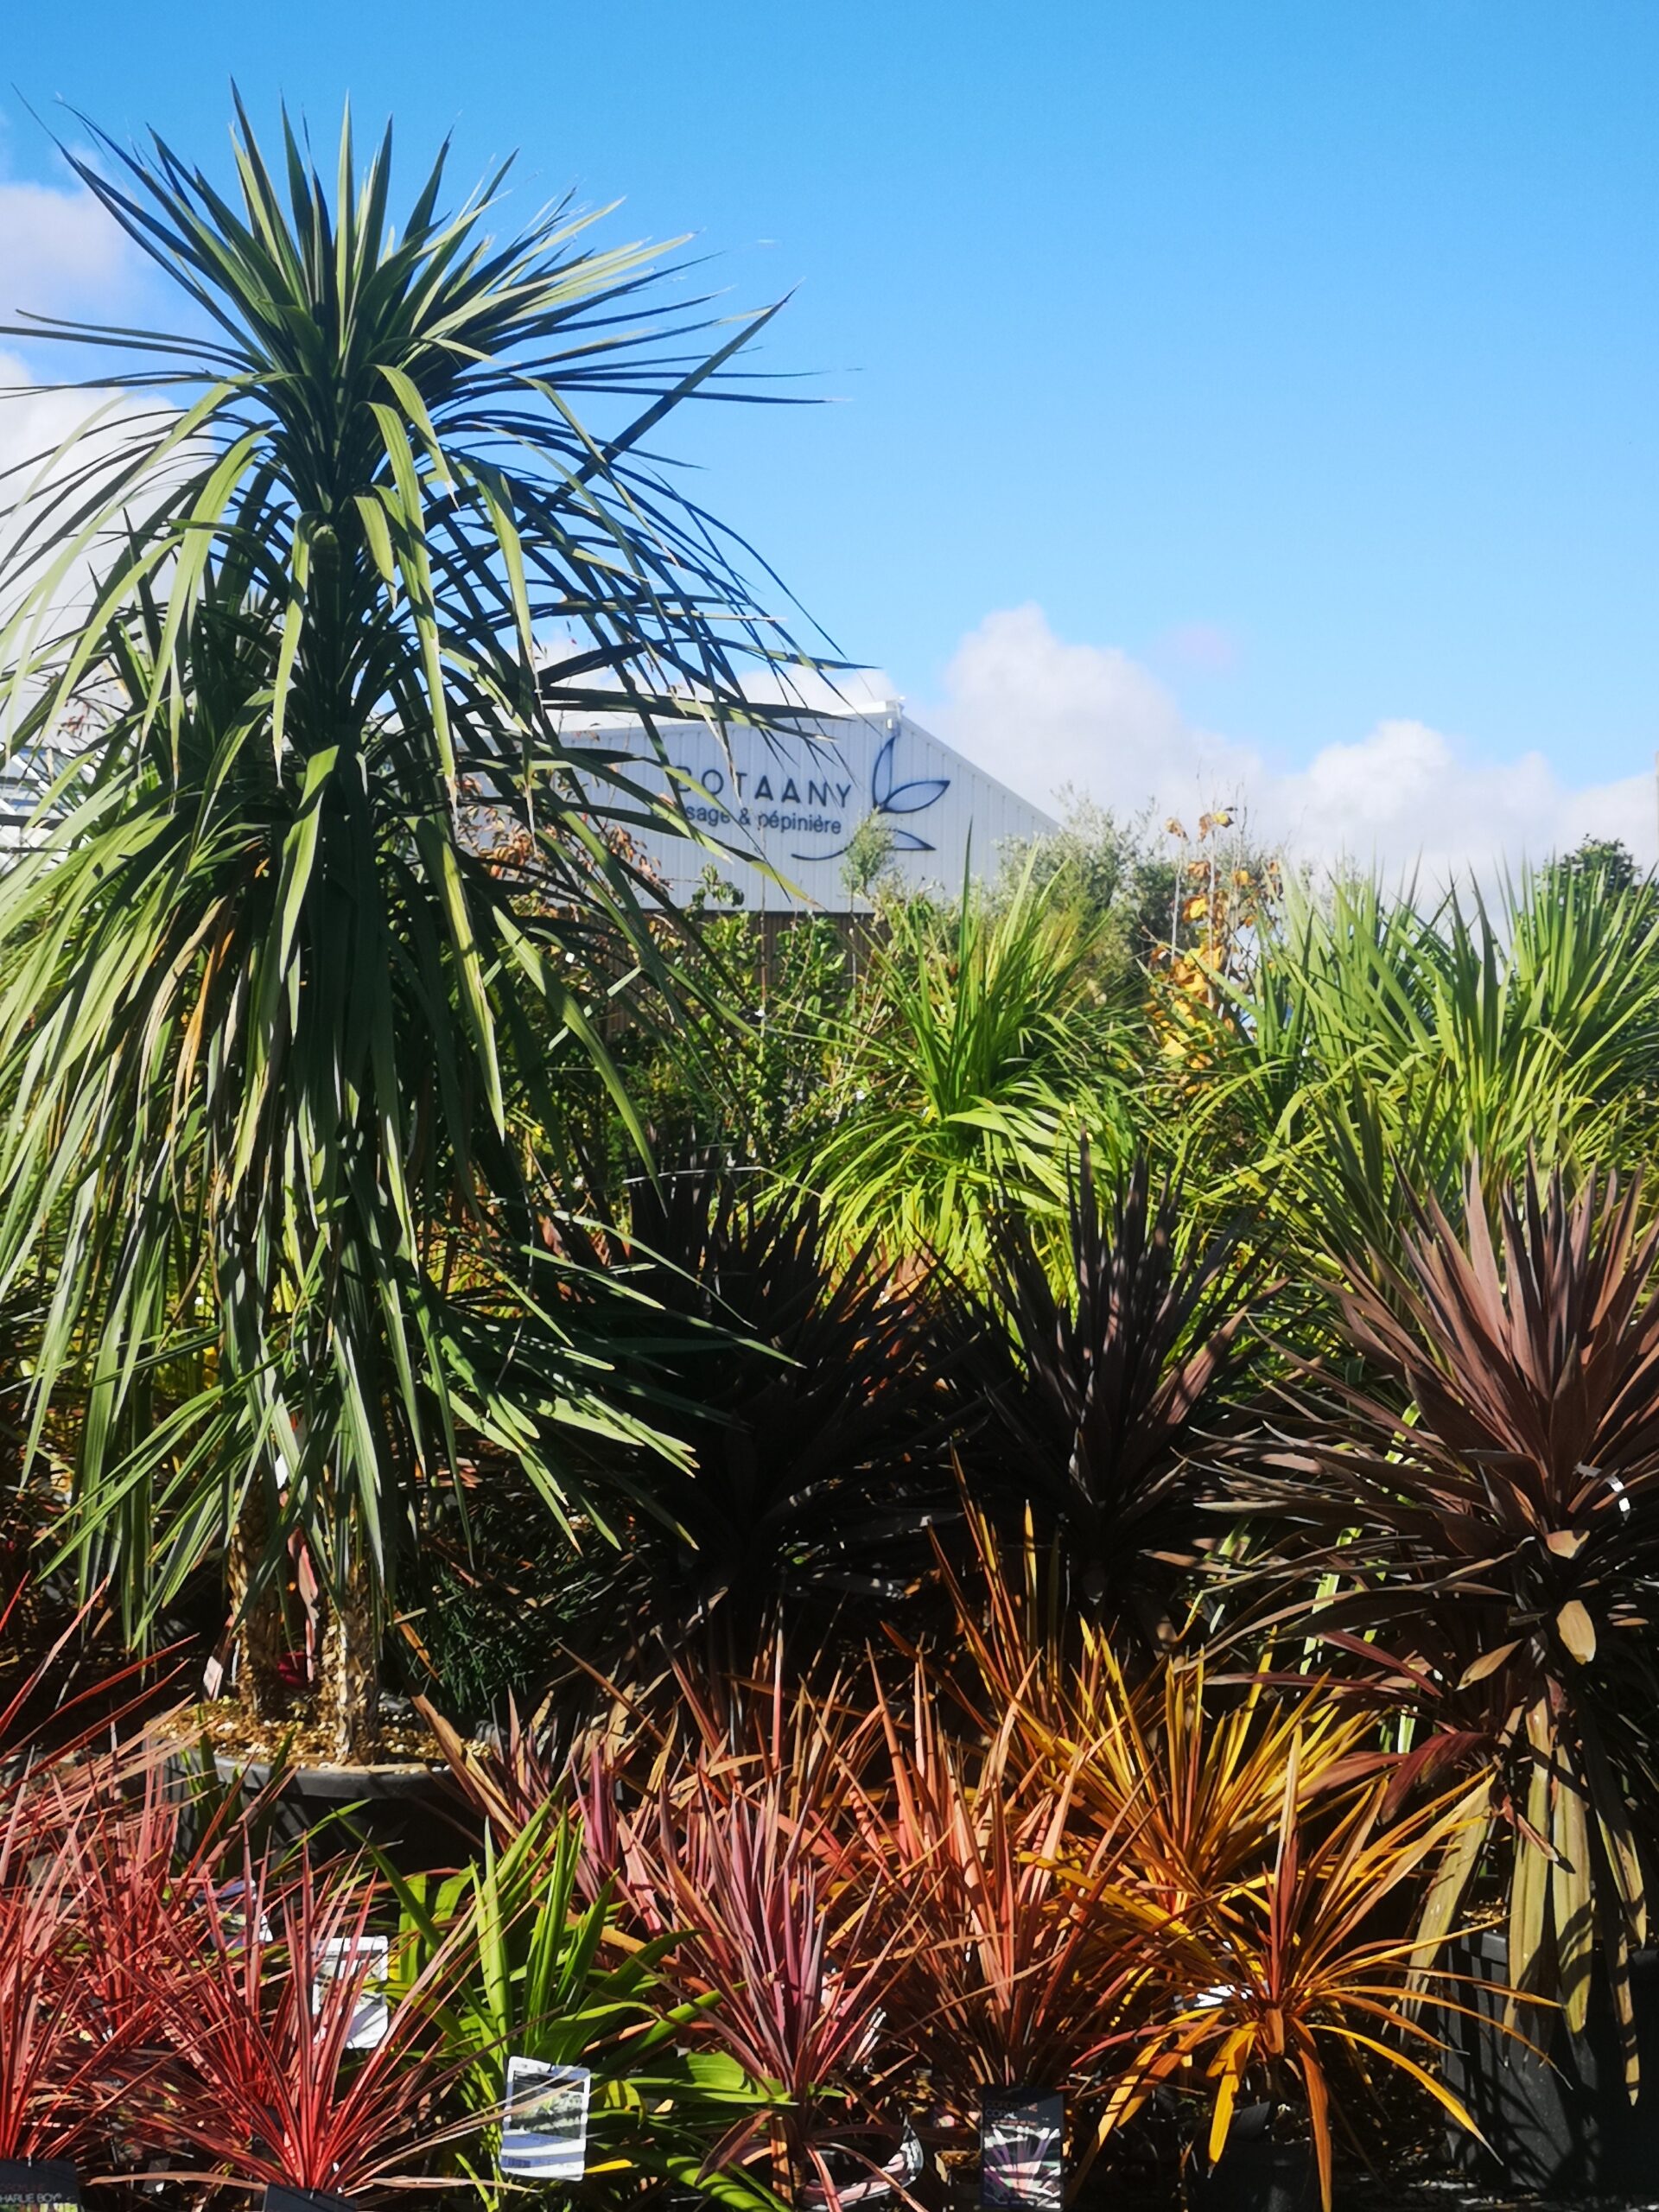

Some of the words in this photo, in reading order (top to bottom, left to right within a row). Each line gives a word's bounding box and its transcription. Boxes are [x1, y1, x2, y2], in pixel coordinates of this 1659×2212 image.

[739, 807, 751, 826] &
[758, 809, 842, 835] pépinière
[0, 2192, 35, 2203] HARLIE
